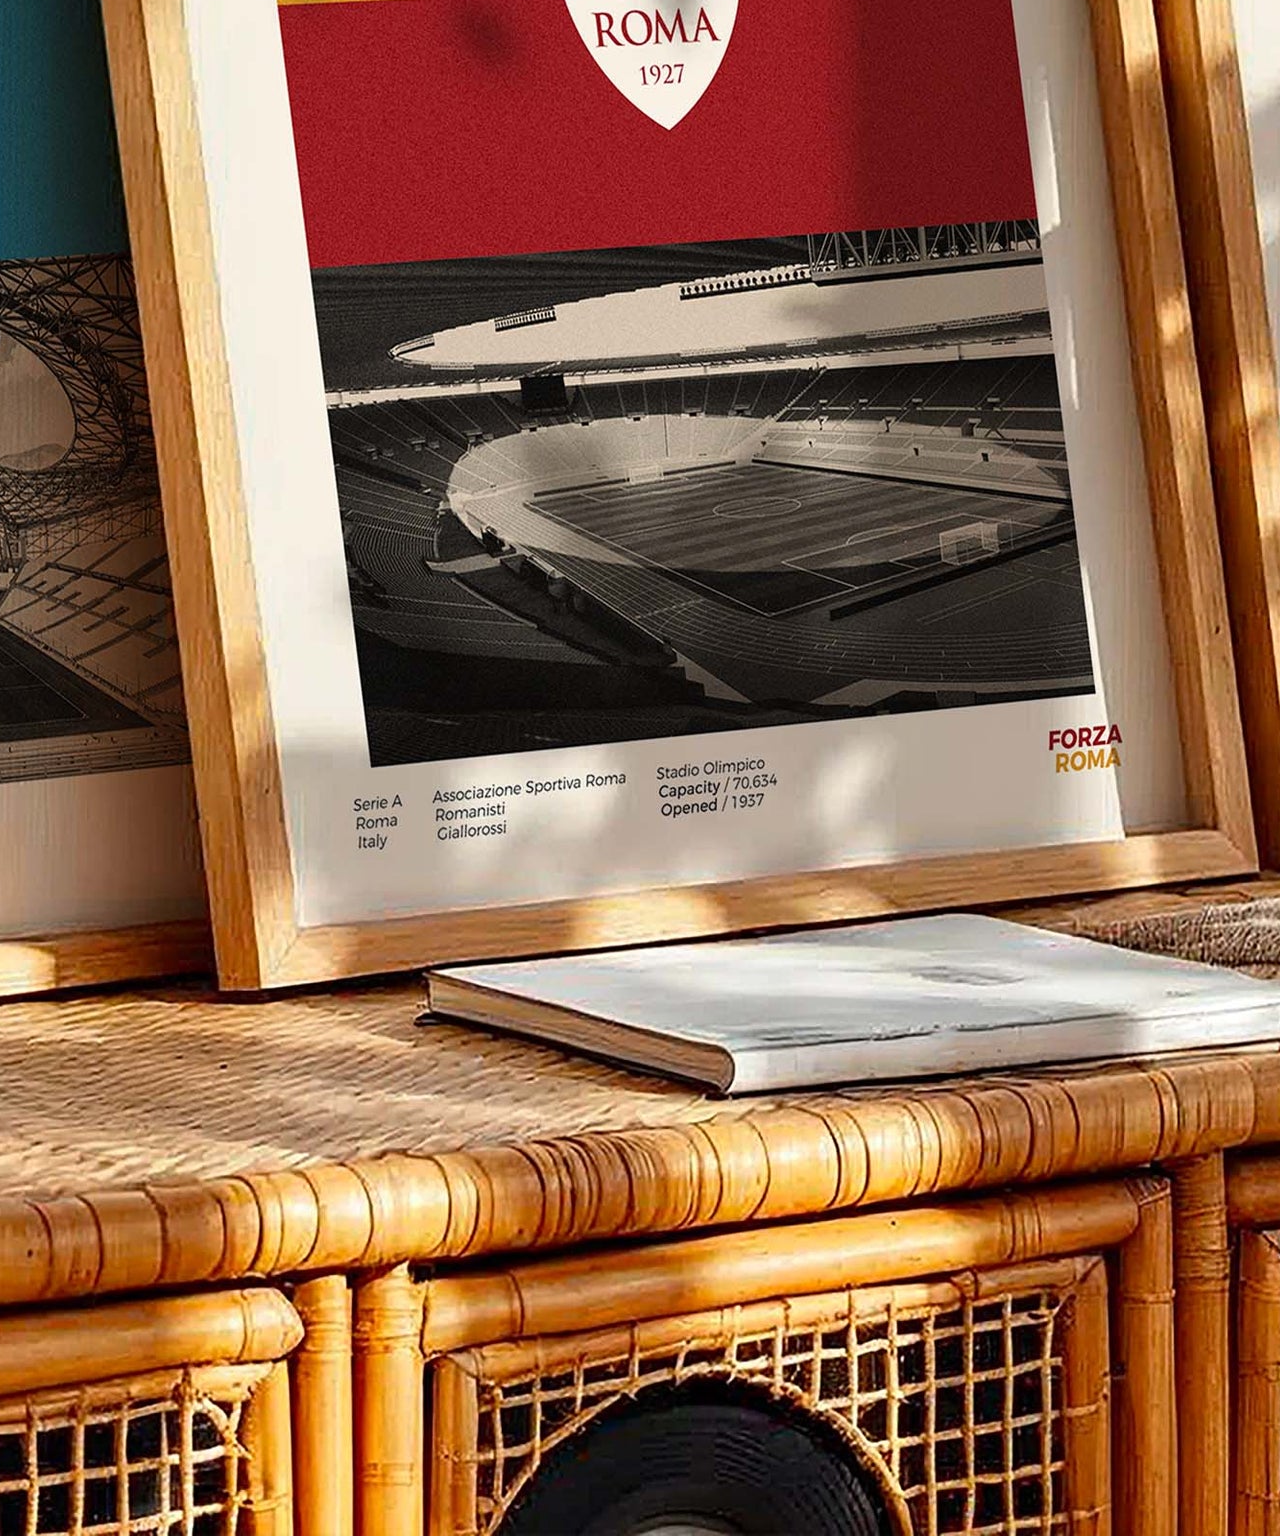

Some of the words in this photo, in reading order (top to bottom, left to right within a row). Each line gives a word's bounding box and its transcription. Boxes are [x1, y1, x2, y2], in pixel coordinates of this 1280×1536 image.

[592, 7, 721, 48] ROMA
[640, 64, 685, 85] 1927
[1049, 724, 1122, 750] FORZA
[656, 763, 700, 780] Stadio
[703, 757, 765, 775] Olimpico
[1056, 747, 1121, 773] ROMA
[432, 784, 522, 804] Associazione
[525, 776, 581, 796] Sportiva
[585, 773, 626, 787] Roma
[658, 780, 721, 800] Capacity
[353, 796, 388, 812] Serie
[391, 794, 403, 808] A
[435, 801, 505, 822] Romanisti
[660, 797, 718, 819] Opened
[731, 792, 765, 809] 1937
[356, 815, 398, 830] Roma
[437, 819, 507, 841] Giallorossi
[358, 833, 388, 850] Italy
